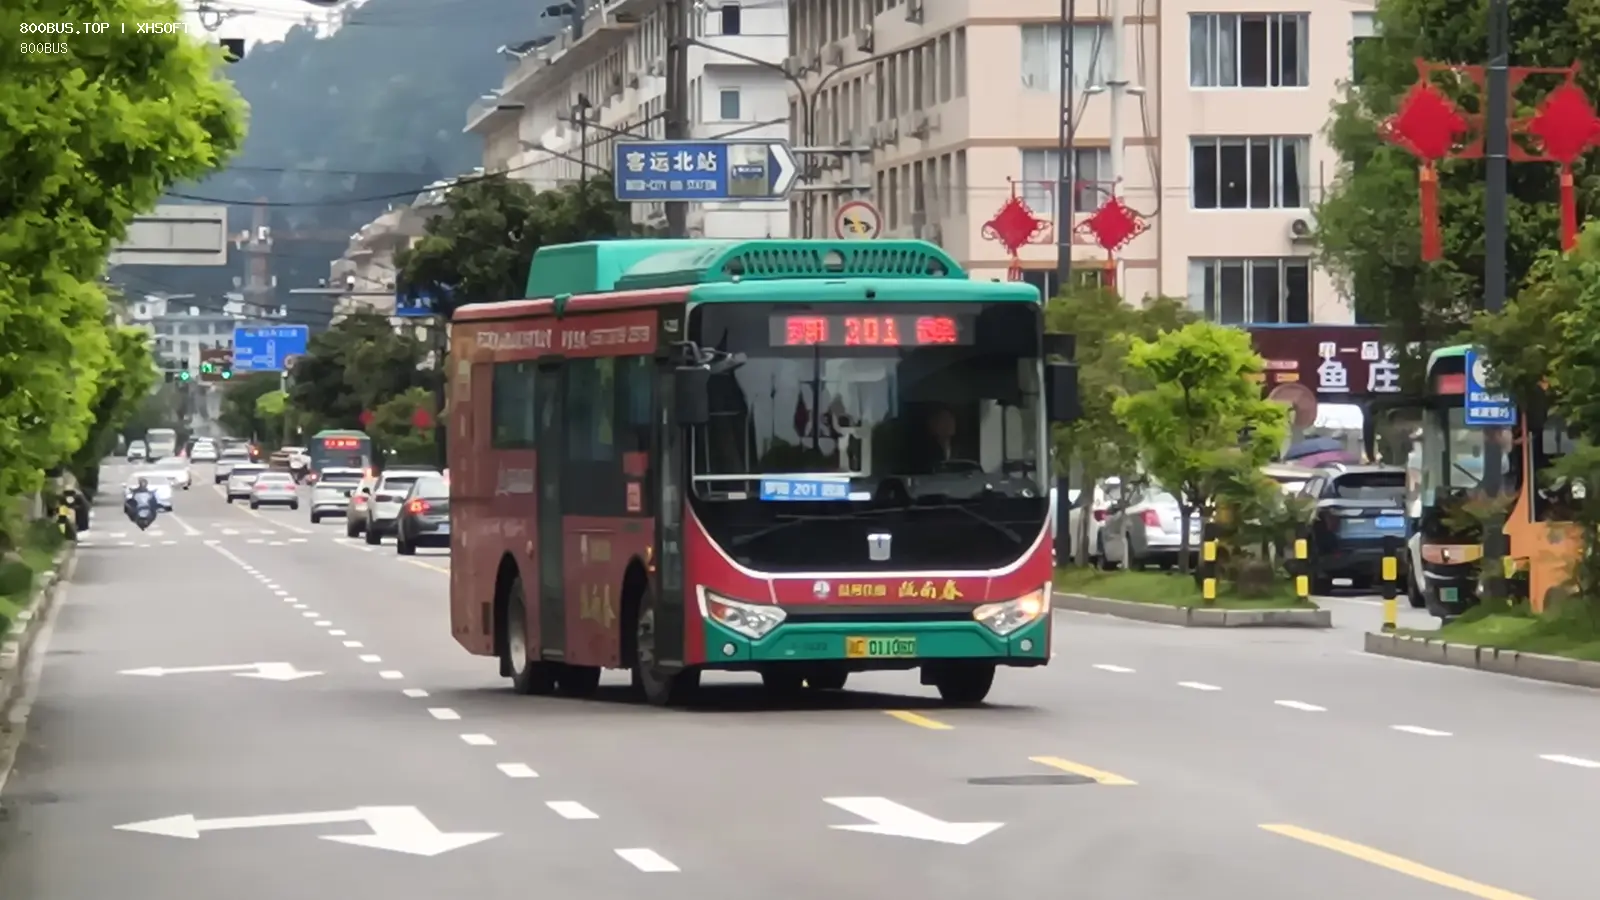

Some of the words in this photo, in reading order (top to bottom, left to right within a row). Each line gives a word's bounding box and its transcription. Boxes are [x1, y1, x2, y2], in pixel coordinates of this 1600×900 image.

[626, 151, 717, 172] 客运北站
[1317, 360, 1401, 392] 鱼庄
[793, 483, 818, 496] 201
